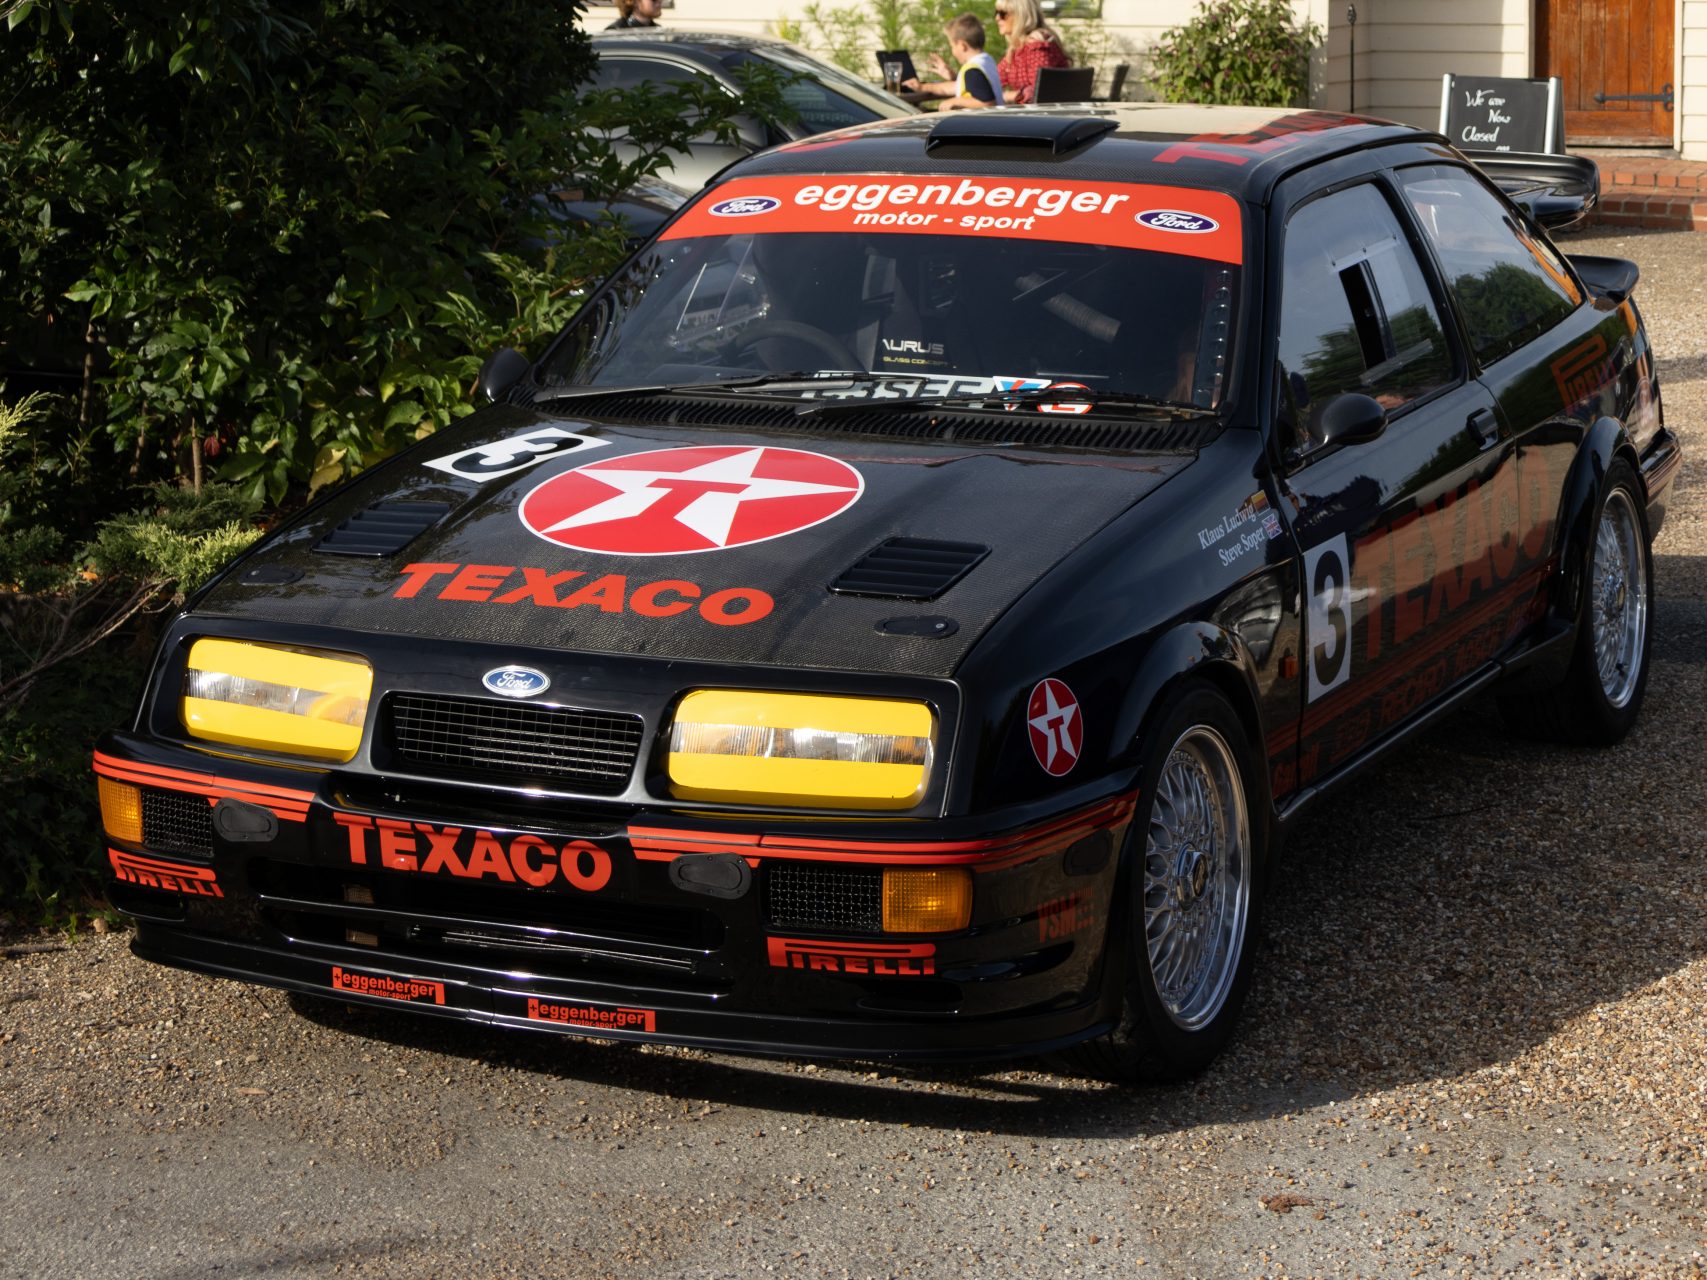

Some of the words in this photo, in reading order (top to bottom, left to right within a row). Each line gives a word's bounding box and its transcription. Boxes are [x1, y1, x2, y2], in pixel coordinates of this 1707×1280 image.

[1488, 108, 1512, 124] Now
[1461, 126, 1501, 143] Closed
[721, 199, 768, 214] Ford
[794, 178, 1130, 217] eggenberger
[852, 210, 938, 226] motor
[959, 212, 1036, 232] sport
[1149, 212, 1203, 231] Ford
[1197, 523, 1226, 550] Klaus
[1222, 502, 1257, 534] Ludwig
[1218, 542, 1244, 567] Steve
[1240, 526, 1266, 551] Soper
[1353, 443, 1550, 663] TEXACO
[393, 563, 775, 626] TEXACO
[1312, 549, 1347, 687] 3
[496, 671, 535, 689] Ford
[332, 811, 613, 892] TEXACO
[107, 847, 225, 899] PIRELLI
[767, 936, 937, 976] PIRELLI
[342, 973, 435, 998] eggenberger
[368, 988, 411, 1001] motor-sport
[539, 1003, 645, 1027] eggenberger
[569, 1018, 618, 1029] motor-sport
